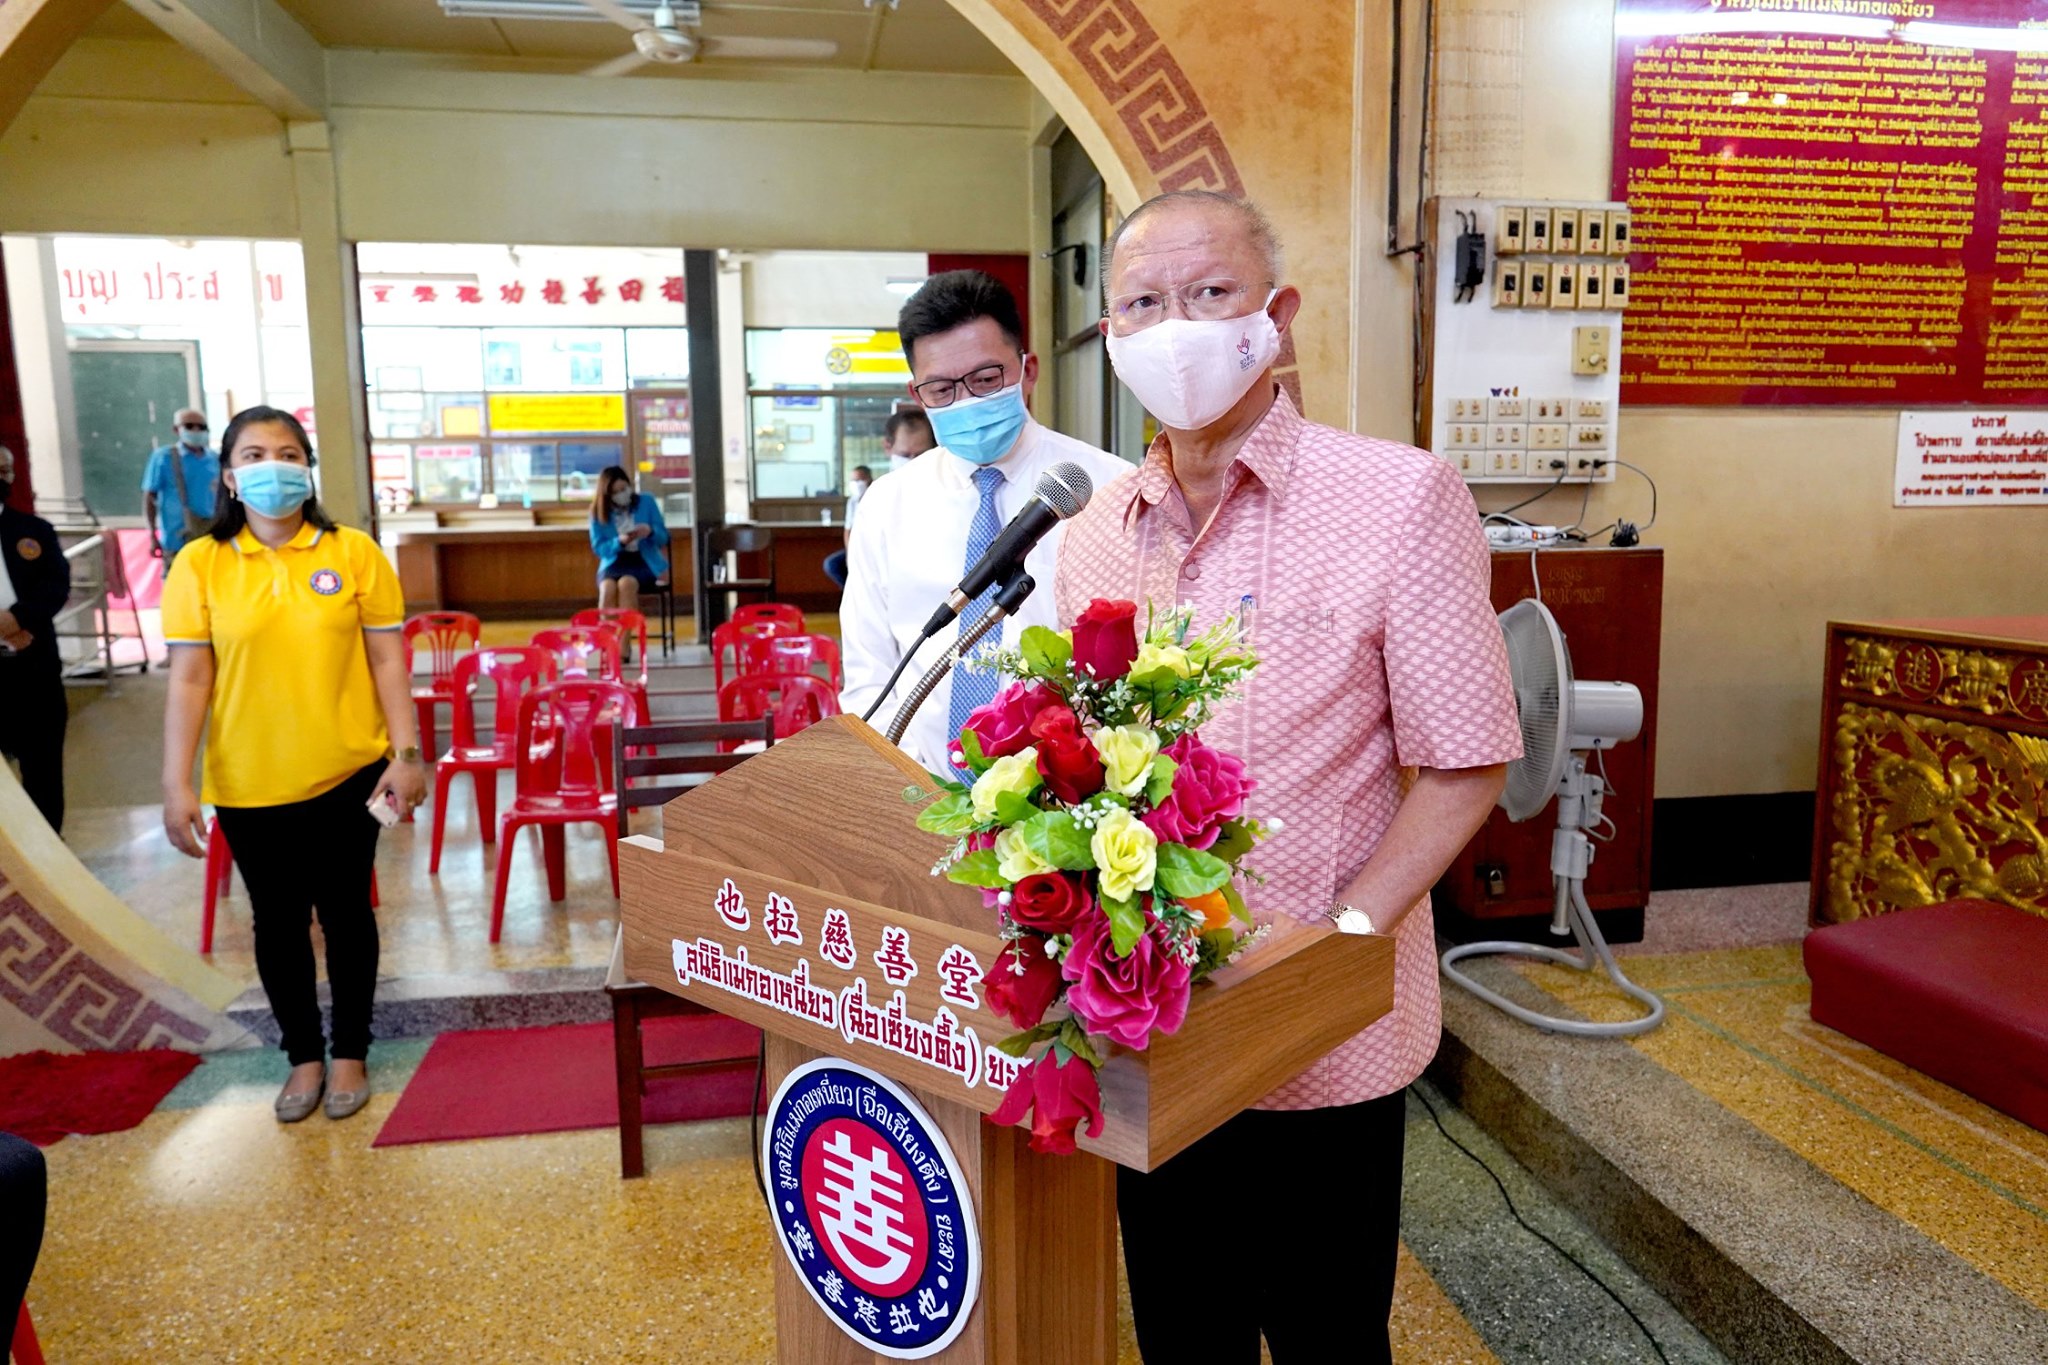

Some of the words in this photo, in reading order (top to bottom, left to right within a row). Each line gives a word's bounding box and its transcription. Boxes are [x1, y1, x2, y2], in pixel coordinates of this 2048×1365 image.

[1511, 239, 1515, 248] 1
[1536, 239, 1543, 249] 2
[1563, 240, 1570, 250] 3
[1591, 241, 1598, 250] 4
[1617, 241, 1624, 251] 5
[1563, 265, 1570, 275] 8
[1590, 265, 1597, 275] 9
[1615, 266, 1625, 276] 10
[63, 269, 118, 315] บุญ
[1534, 292, 1540, 302] 7
[1505, 292, 1512, 303] 6
[1972, 414, 2007, 428] ประกาศ
[718, 882, 980, 1003] 也拉慈善堂
[678, 941, 834, 1025] ูลนิธิแม่กอเหนี่ยว
[988, 1053, 1027, 1088] ยะ
